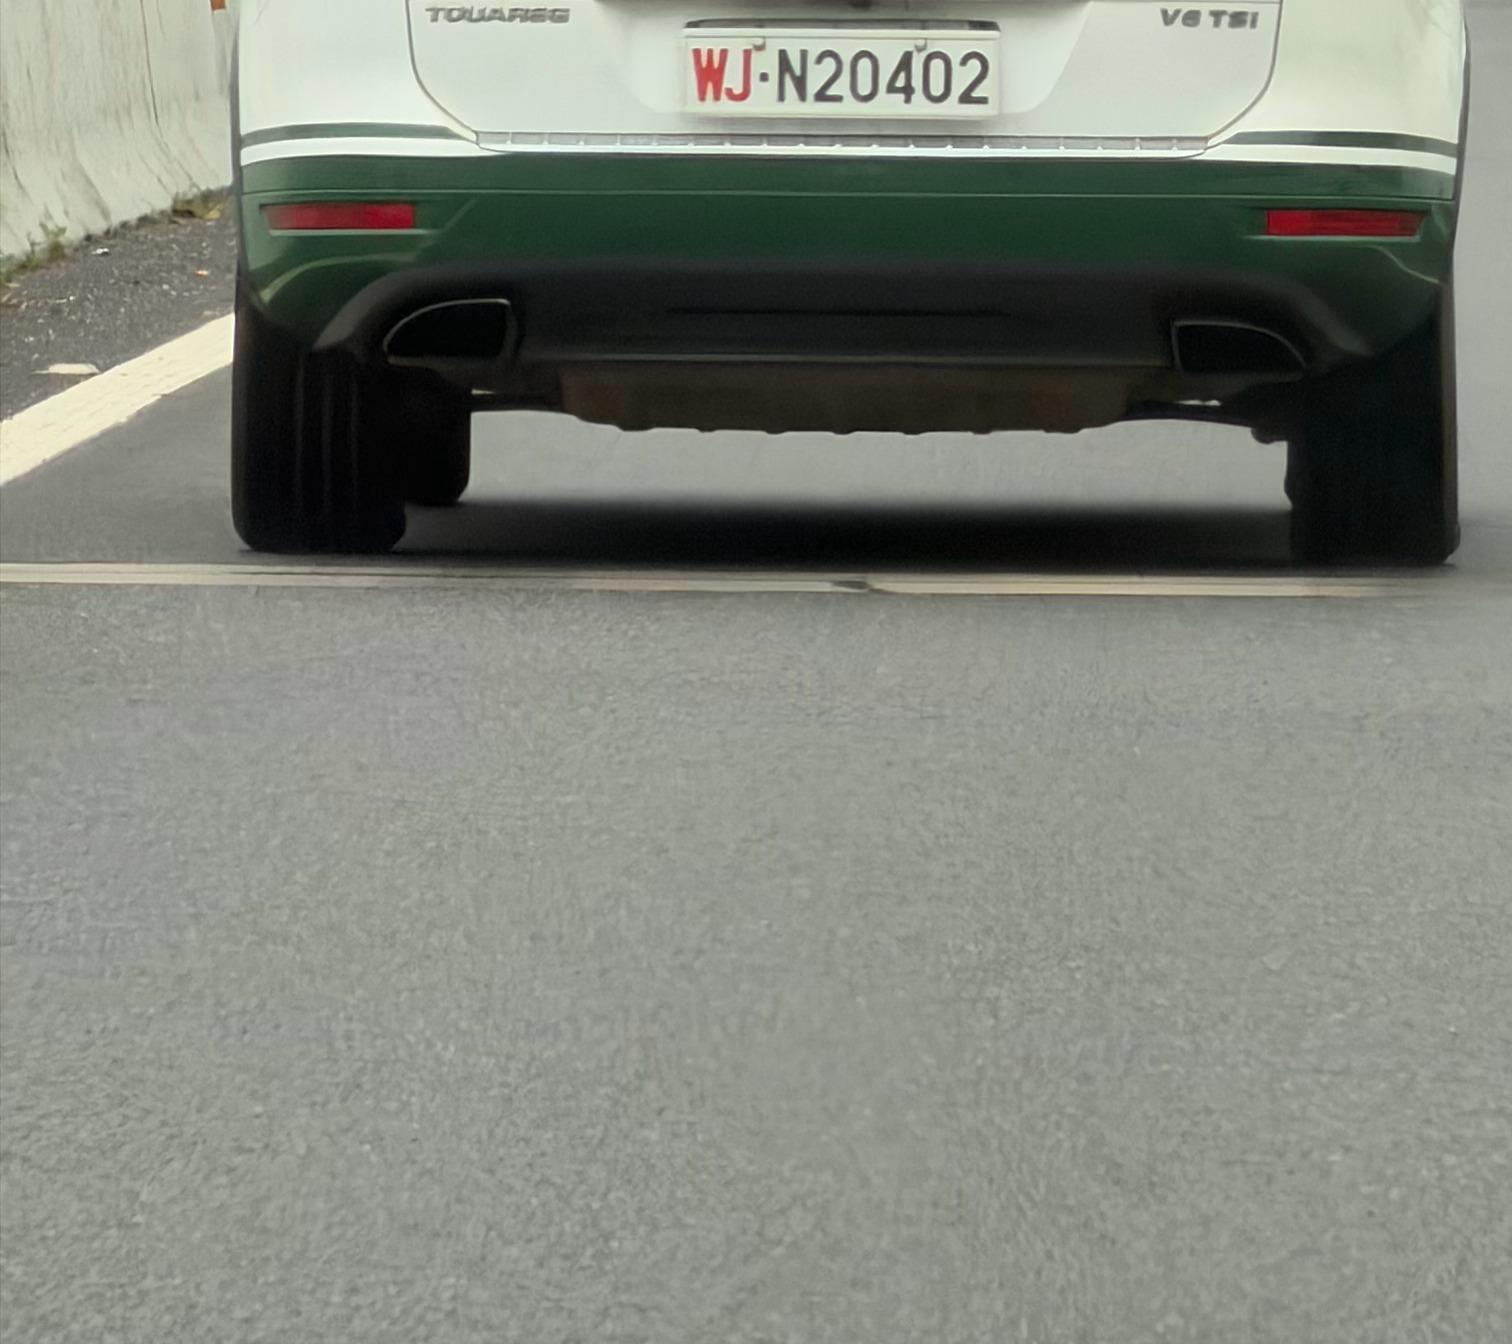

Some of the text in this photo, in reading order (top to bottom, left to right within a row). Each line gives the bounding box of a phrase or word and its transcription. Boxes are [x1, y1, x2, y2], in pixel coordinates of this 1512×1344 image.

[425, 6, 570, 23] TOUAREG
[1160, 8, 1259, 29] V6 TSI
